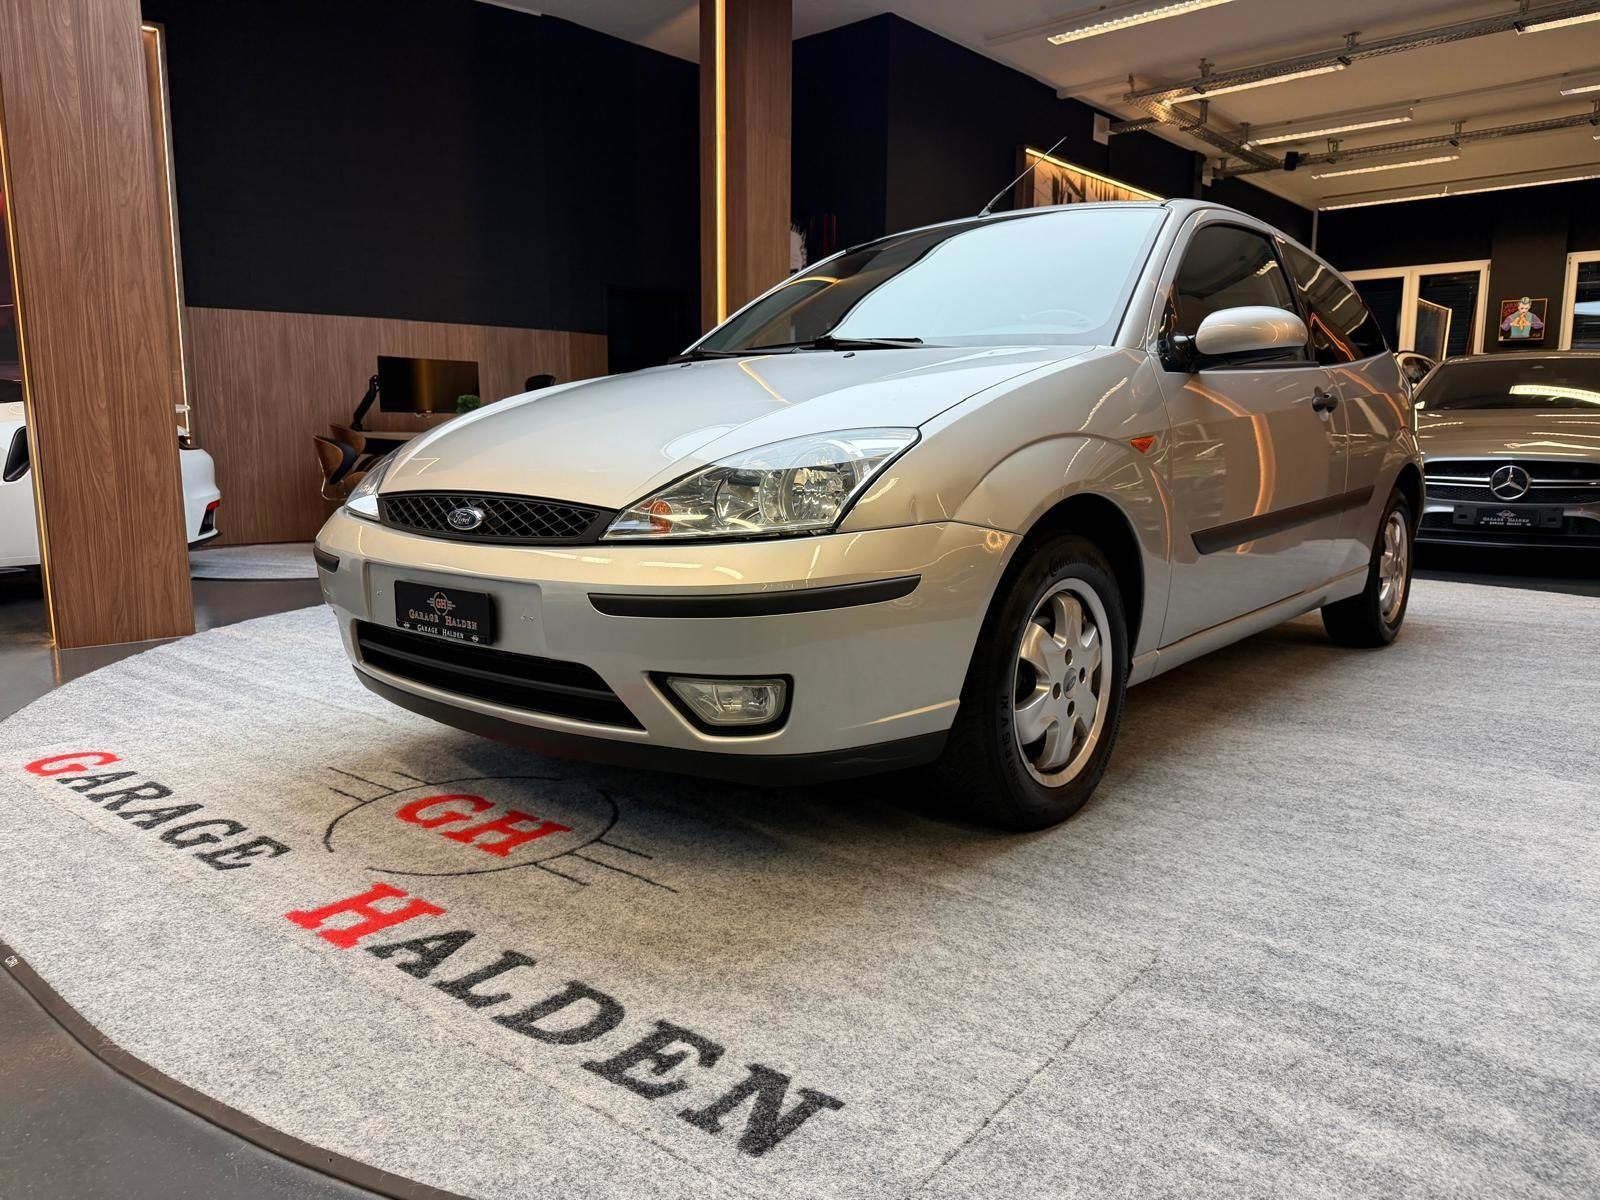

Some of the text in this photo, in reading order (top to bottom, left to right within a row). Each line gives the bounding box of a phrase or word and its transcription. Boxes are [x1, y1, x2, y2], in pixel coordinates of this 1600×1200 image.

[453, 511, 471, 525] Ford
[408, 608, 478, 631] GARAGE HALDEN
[435, 598, 447, 609] GH
[24, 750, 292, 871] GARAGE
[395, 793, 572, 858] GH
[283, 881, 846, 1158] HALDEN
